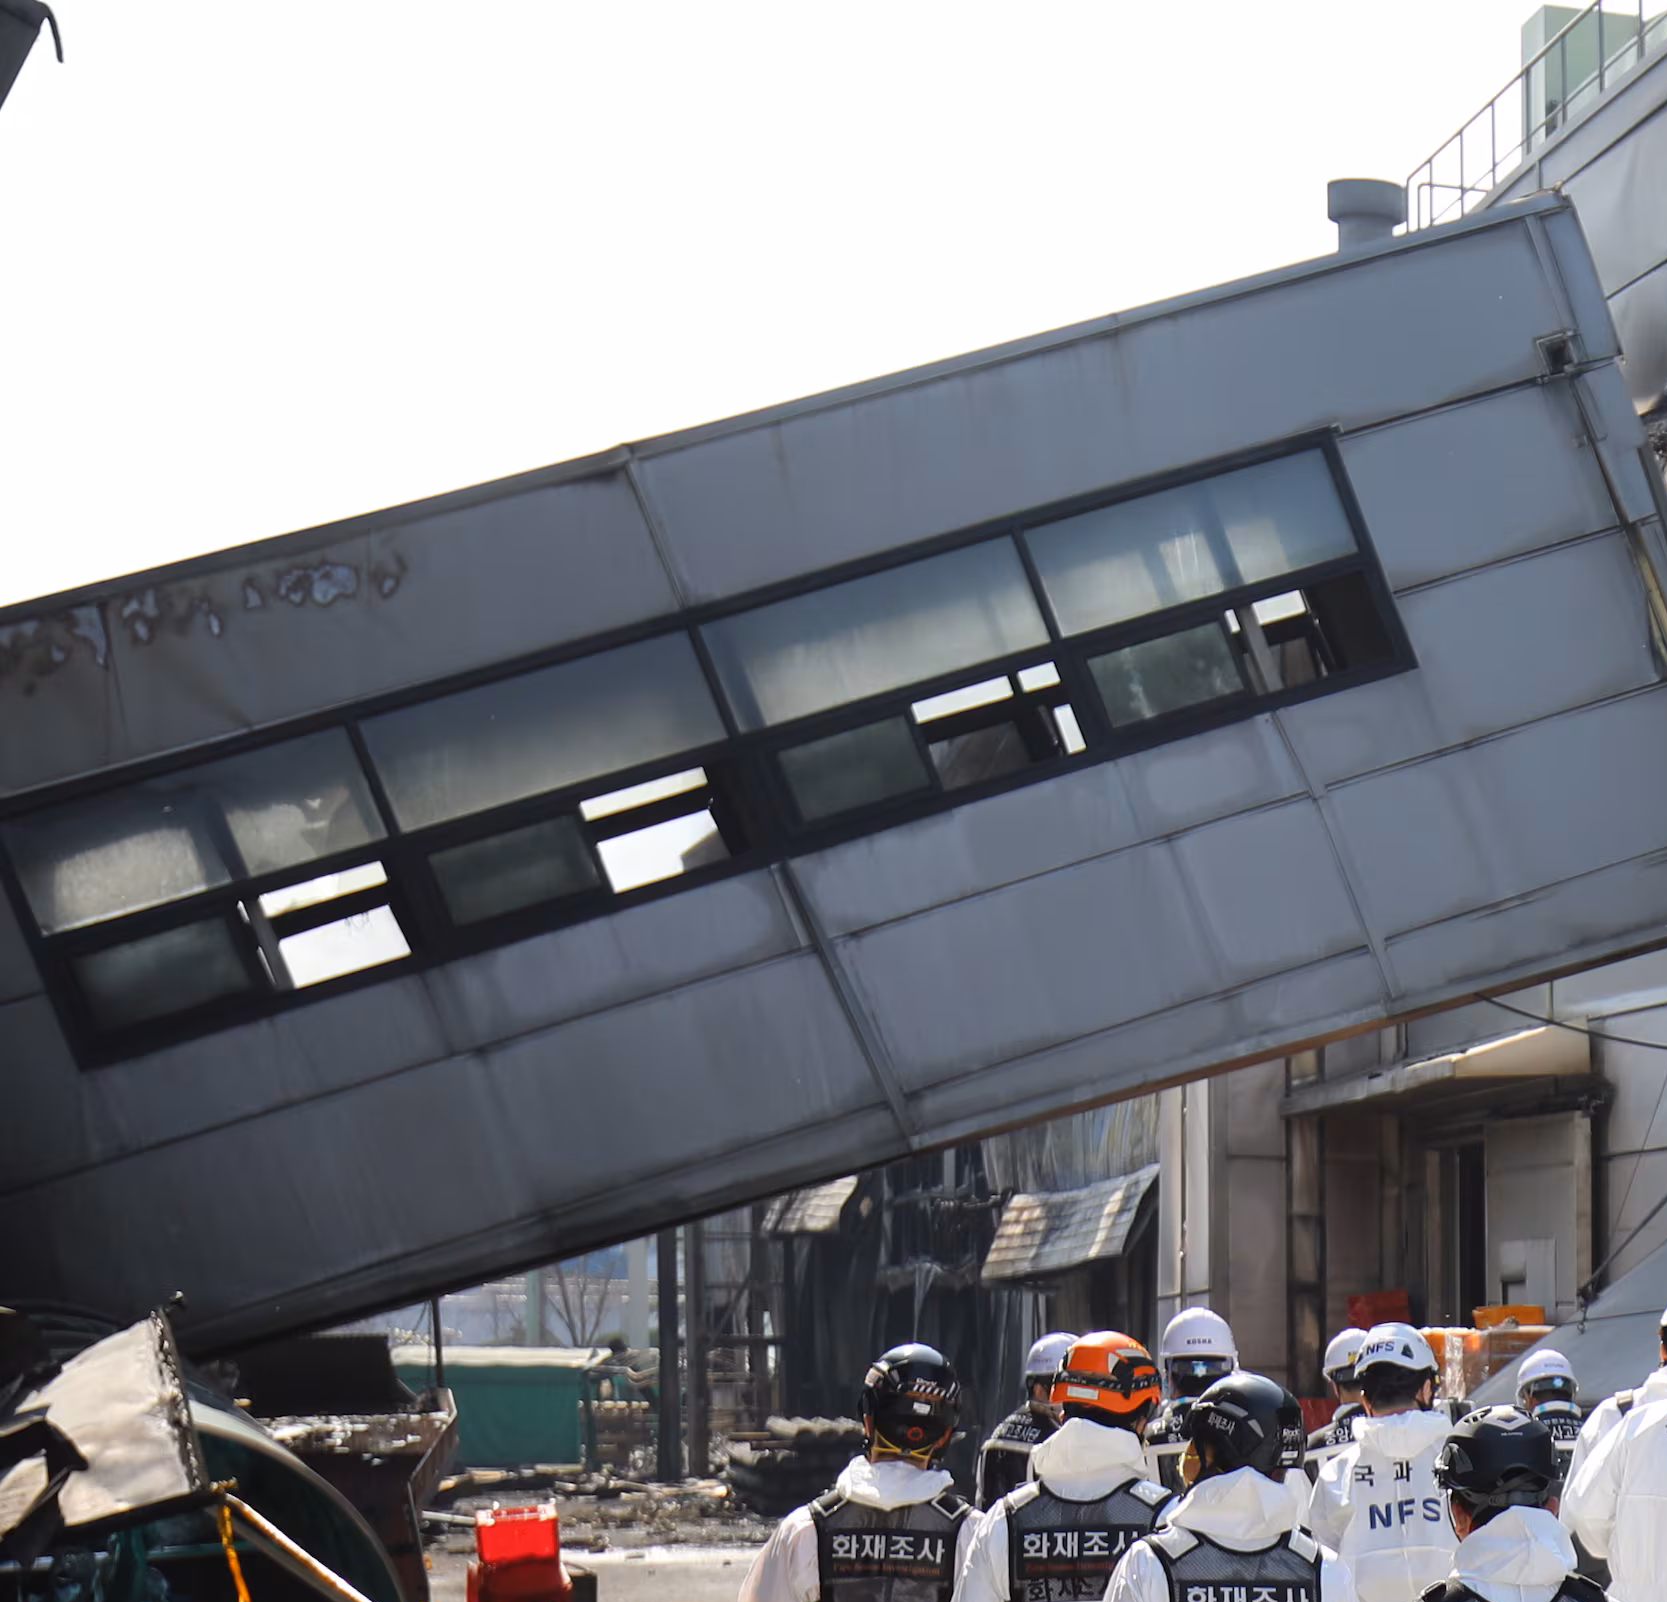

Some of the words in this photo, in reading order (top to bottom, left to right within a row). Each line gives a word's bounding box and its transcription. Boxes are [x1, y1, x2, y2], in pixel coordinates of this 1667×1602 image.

[1366, 1341, 1395, 1354] NFS
[1355, 1459, 1413, 1487] 국과
[1369, 1497, 1442, 1530] NFS
[832, 1534, 946, 1564] 화재조사
